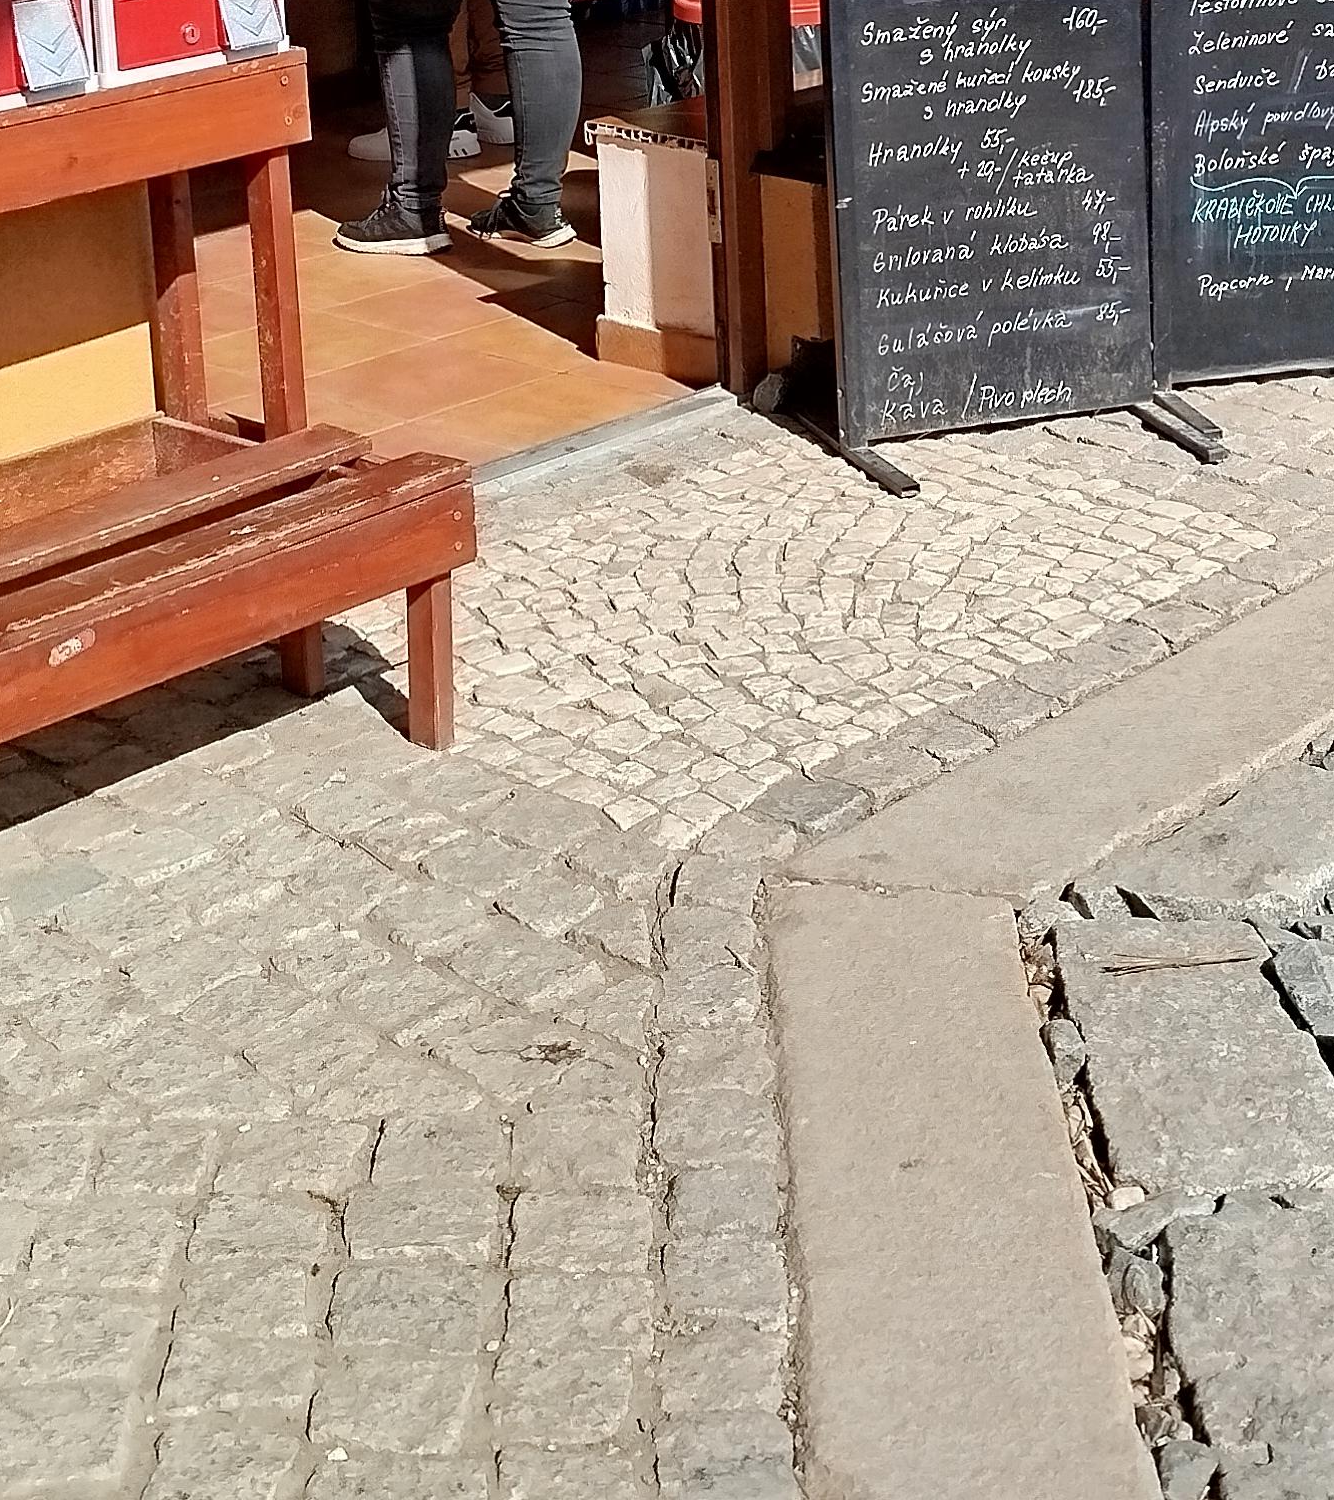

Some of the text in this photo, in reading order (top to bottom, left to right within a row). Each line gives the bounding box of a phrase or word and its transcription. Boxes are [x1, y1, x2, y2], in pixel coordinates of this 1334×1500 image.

[860, 11, 960, 47] Smažený
[971, 7, 1007, 42] sýr
[943, 33, 1033, 66] hranolky
[860, 70, 948, 105] Smažené
[1193, 67, 1281, 95] Sendviče
[945, 90, 1027, 119] hranolky
[1193, 102, 1256, 143] Alpský
[868, 135, 964, 168] Hranolky
[1193, 141, 1287, 178] Boloňské
[873, 204, 935, 235] Párek
[942, 209, 955, 226] v
[965, 196, 1039, 222] rohlíku
[873, 230, 978, 273] Grilovaná
[989, 227, 1069, 256] klobása
[876, 279, 970, 309] Kukuřice
[982, 278, 994, 292] v
[1000, 263, 1082, 292] kelímku
[878, 310, 984, 356] Gulášová
[988, 307, 1073, 347] polévka
